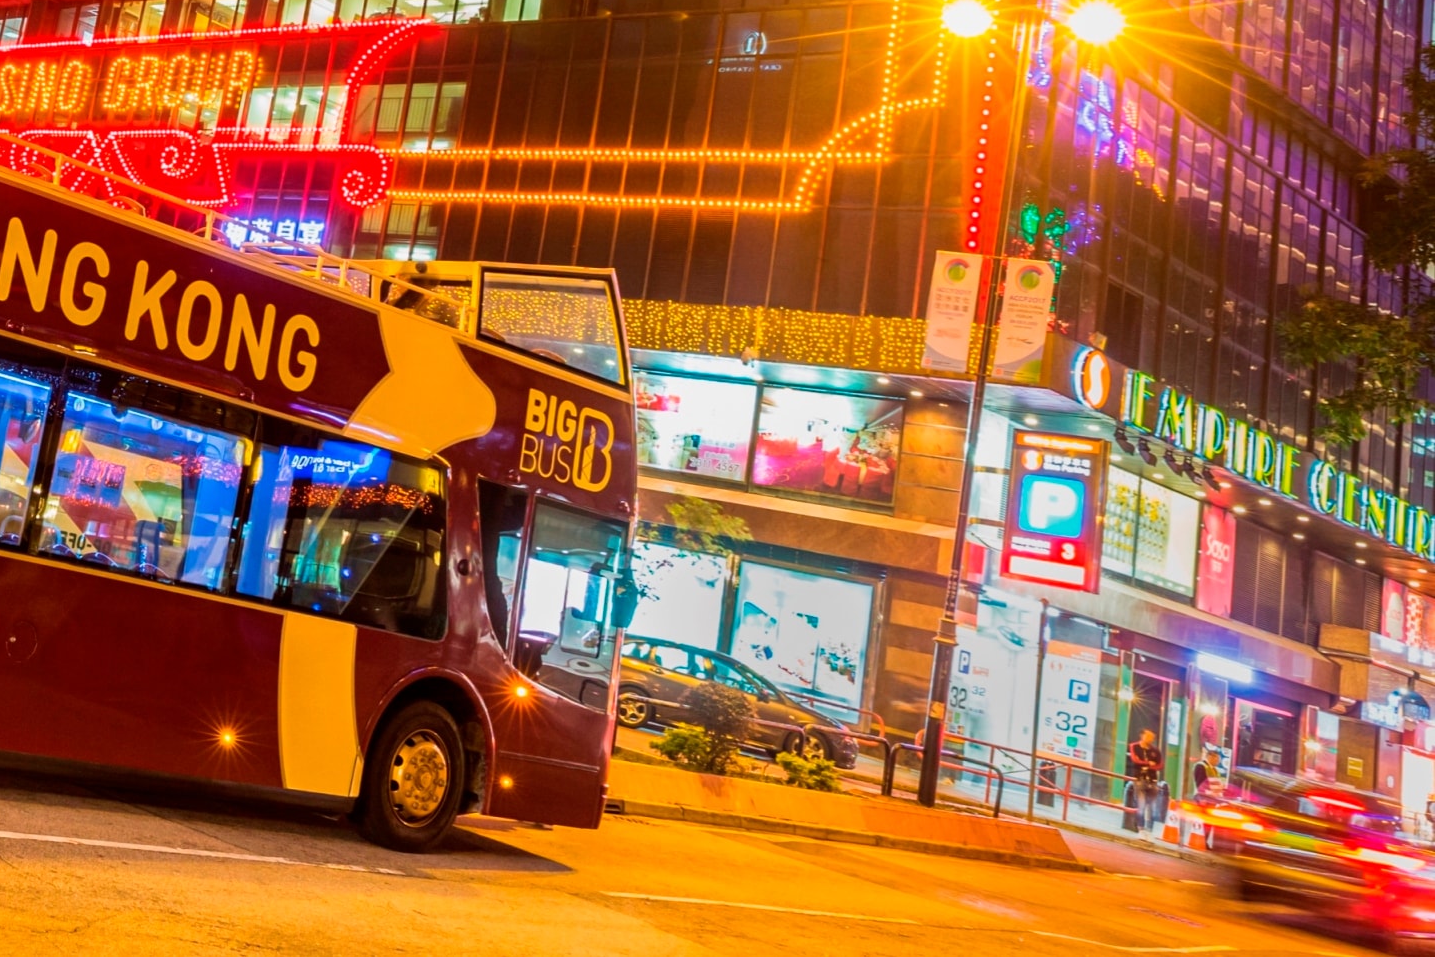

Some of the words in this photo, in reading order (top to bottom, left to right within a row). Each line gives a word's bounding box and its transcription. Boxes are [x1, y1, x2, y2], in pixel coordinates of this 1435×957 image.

[103, 49, 263, 112] GROUP
[127, 260, 320, 393] KONG
[525, 388, 577, 442] BIG
[519, 433, 572, 483] BUS
[1121, 368, 1301, 500] EMPIRE
[1307, 457, 1435, 564] CENTR
[1028, 480, 1079, 530] P
[1060, 542, 1076, 561] 3
[949, 686, 968, 710] 32
[971, 686, 986, 697] 32
[1070, 681, 1089, 702] P
[1055, 710, 1088, 737] 32
